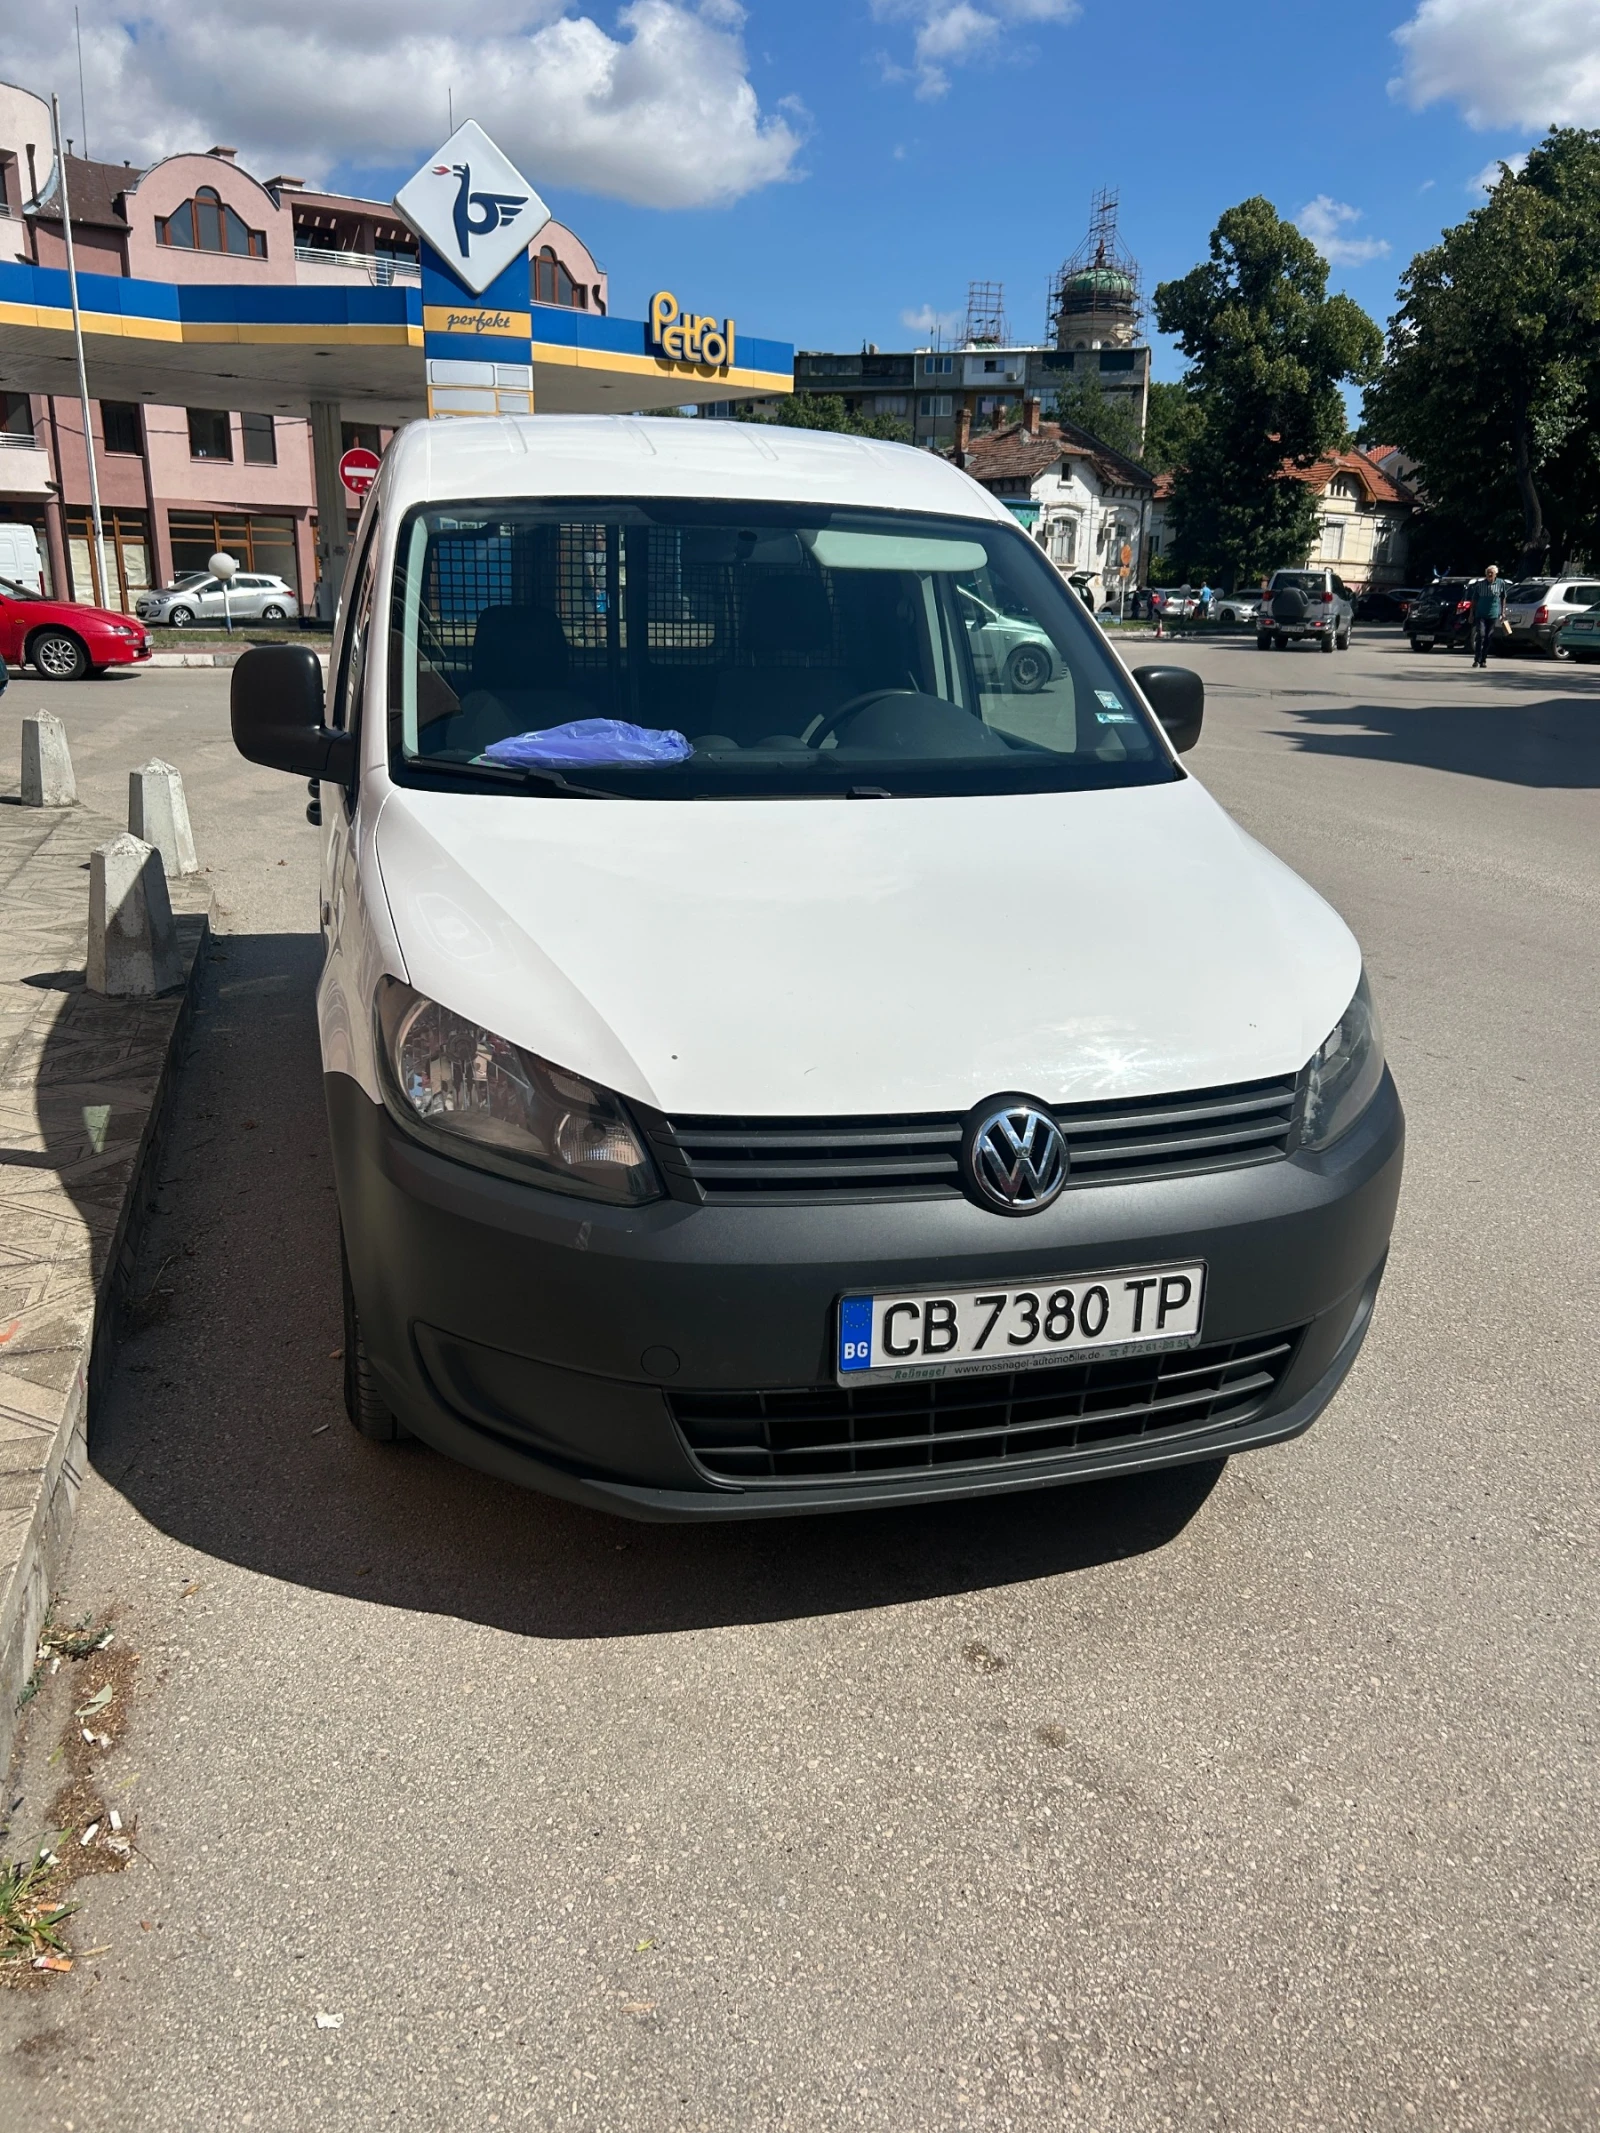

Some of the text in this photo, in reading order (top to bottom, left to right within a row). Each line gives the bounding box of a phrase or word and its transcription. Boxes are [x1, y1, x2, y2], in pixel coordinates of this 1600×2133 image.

[447, 311, 511, 332] perfekt
[649, 291, 735, 368] Petrol
[974, 1107, 1067, 1209] VW
[844, 1341, 868, 1359] BG
[882, 1275, 1192, 1358] CB 7380 TP
